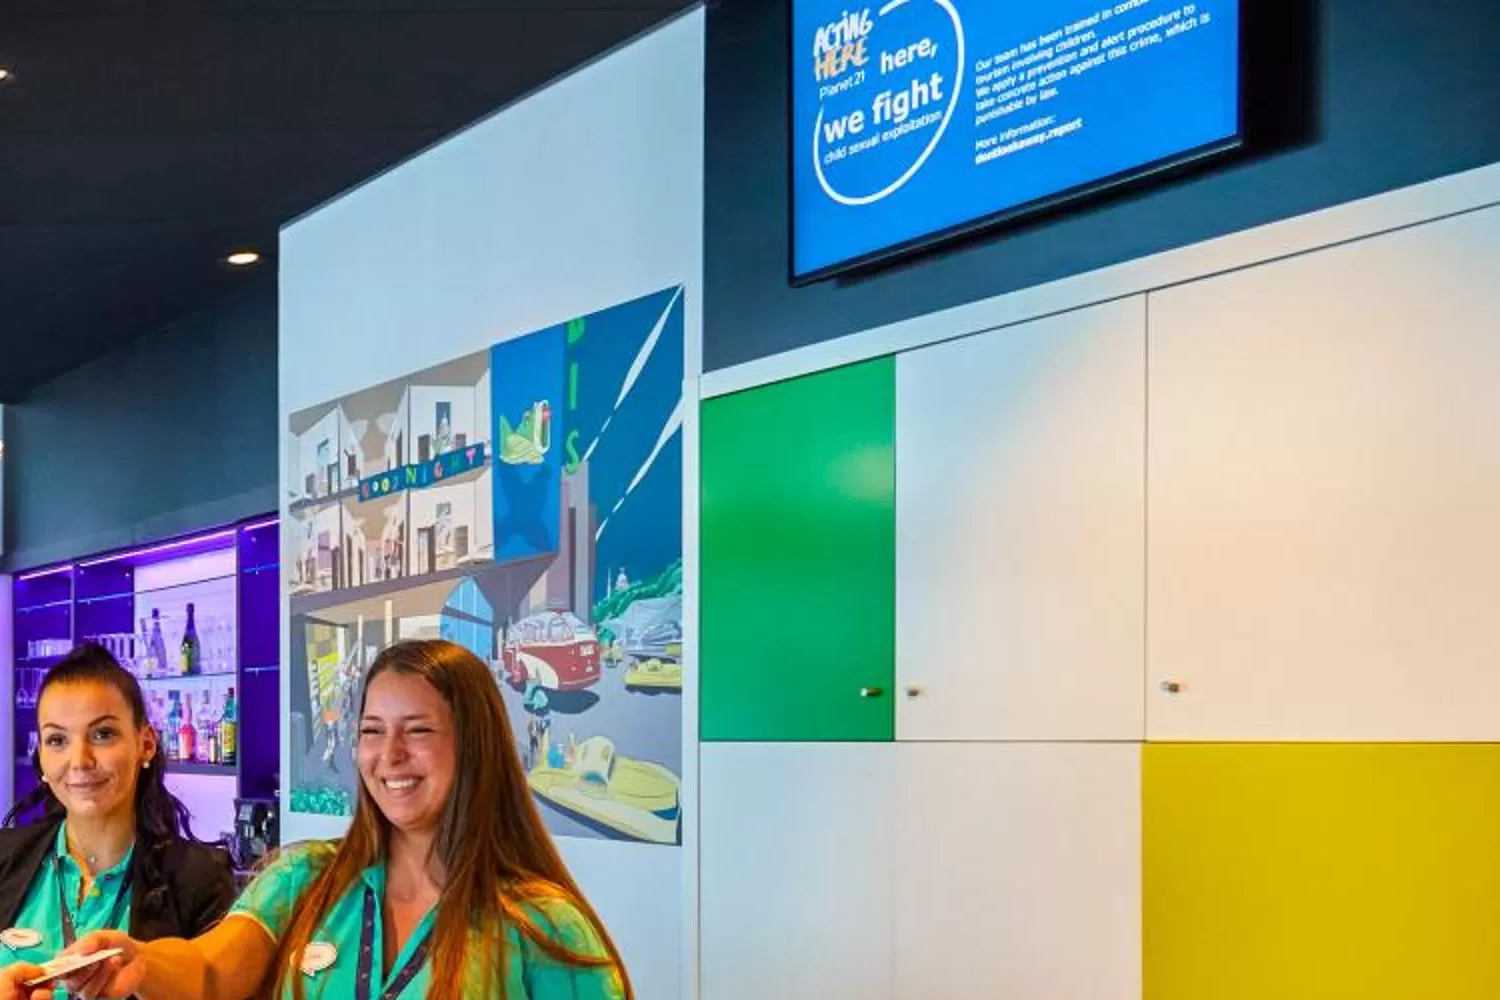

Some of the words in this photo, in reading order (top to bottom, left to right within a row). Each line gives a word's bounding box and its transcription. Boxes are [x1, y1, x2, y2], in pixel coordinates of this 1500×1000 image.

[814, 37, 870, 82] HERE
[880, 37, 937, 75] here,
[975, 57, 993, 72] Our
[994, 48, 1018, 65] team
[1019, 40, 1037, 53] has
[1039, 29, 1063, 46] been
[1064, 12, 1100, 36] trained
[1101, 9, 1113, 20] in
[975, 86, 990, 99] We
[991, 75, 1016, 93] apply
[1027, 51, 1078, 80] prevention
[1079, 40, 1099, 57] and
[1100, 31, 1125, 49] alert
[1127, 9, 1181, 40] procedure
[1183, 4, 1196, 16] to
[975, 65, 1010, 85] tourism
[1011, 47, 1054, 71] involving
[1055, 30, 1097, 53] children.
[975, 98, 995, 112] take
[997, 81, 1037, 103] concrete
[1038, 69, 1067, 87] action
[1069, 53, 1106, 75] against
[1107, 45, 1127, 61] this
[1129, 32, 1162, 52] crime,
[1165, 17, 1197, 37] which
[1199, 11, 1211, 25] is
[823, 109, 865, 143] we
[872, 72, 943, 125] fight
[975, 99, 1024, 127] punishable
[1025, 95, 1038, 107] by
[975, 136, 998, 152] More
[999, 114, 1057, 143] information:
[823, 145, 847, 165] child
[848, 133, 880, 155] sexual
[882, 110, 943, 142] exploitation
